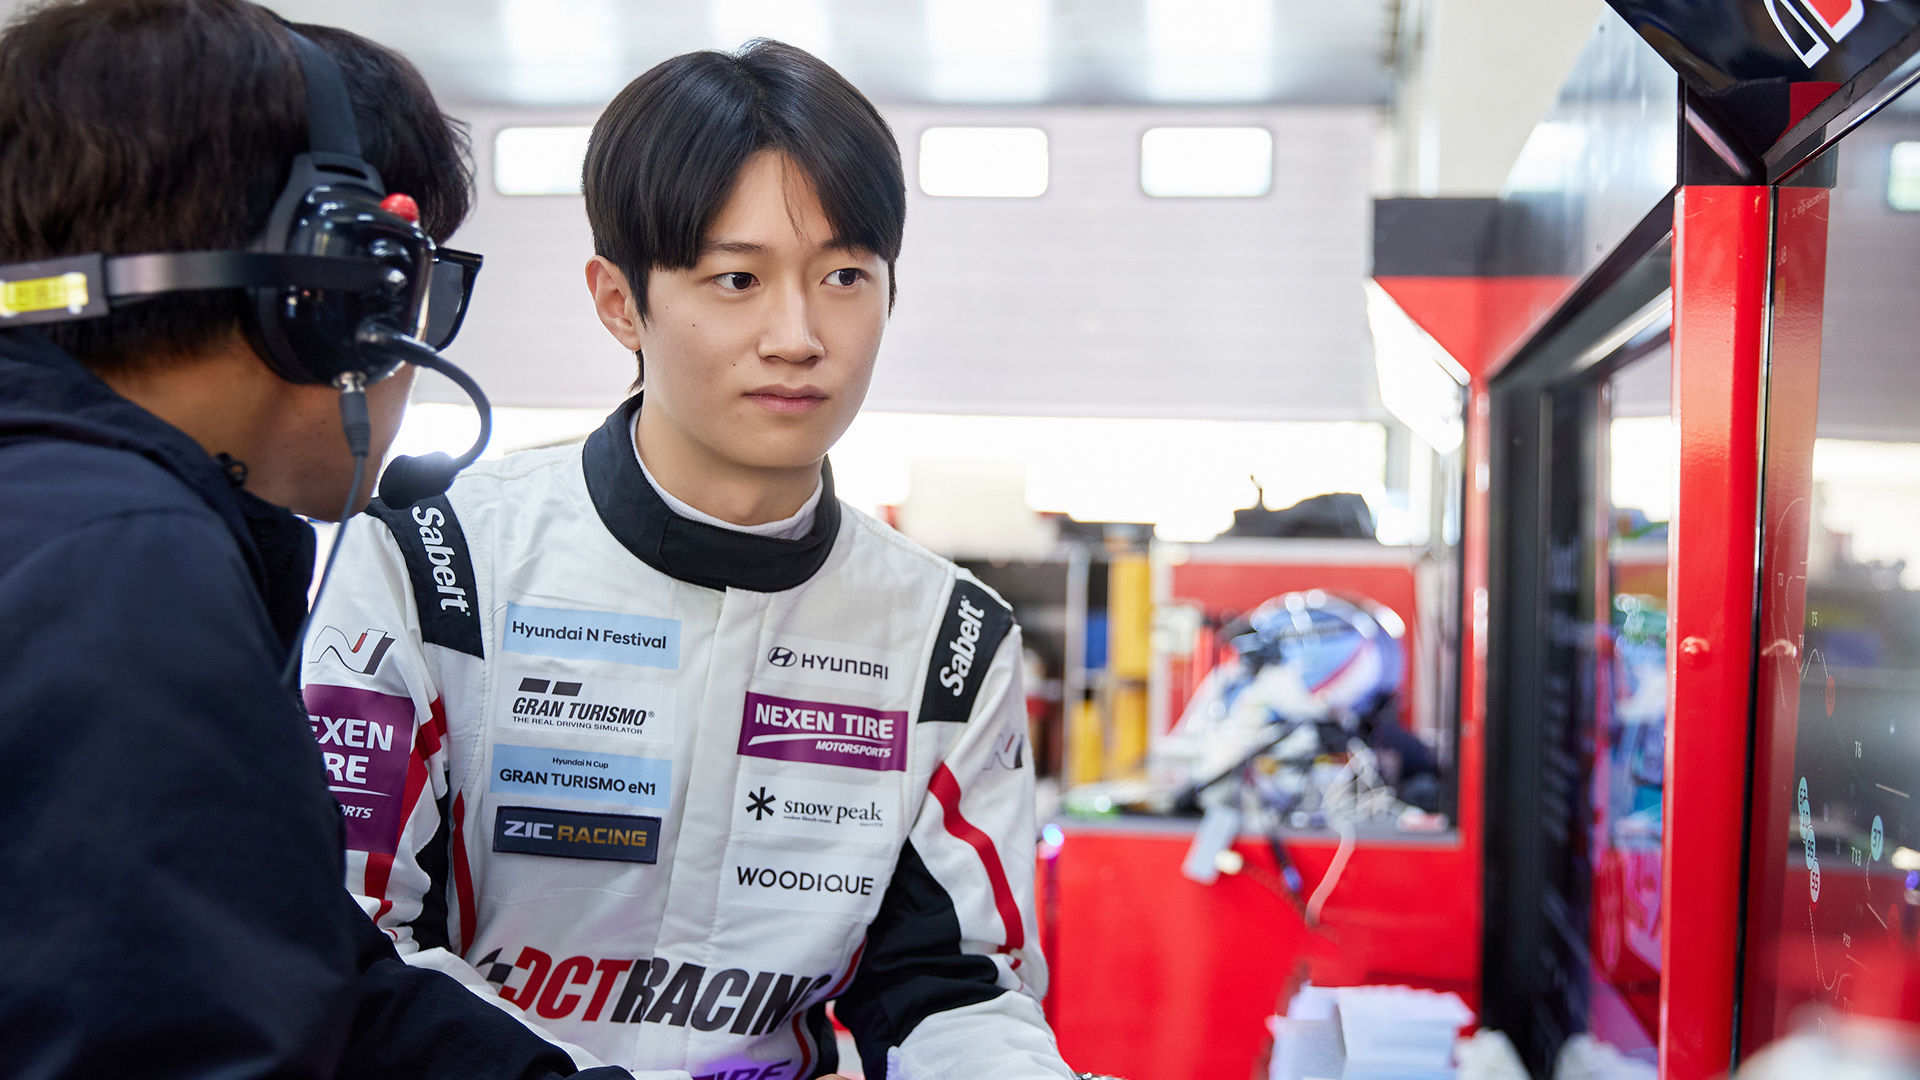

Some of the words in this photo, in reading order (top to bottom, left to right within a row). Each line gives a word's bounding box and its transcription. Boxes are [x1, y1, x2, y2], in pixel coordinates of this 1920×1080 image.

[411, 506, 469, 611] Sabelt
[512, 620, 583, 641] Hyundai
[586, 628, 599, 642] N
[603, 630, 666, 649] Festival
[940, 599, 985, 697] Sabelt
[801, 653, 889, 680] HYUNDAI
[512, 697, 565, 718] GRAN
[755, 702, 835, 732] NEXEN
[841, 713, 894, 739] TIRE
[512, 716, 529, 724] THE
[531, 717, 554, 726] REAL
[556, 720, 592, 730] DRIVING
[593, 723, 643, 735] SIMULATOR
[815, 740, 892, 759] MOTORSPORTS
[1854, 741, 1862, 759] T6
[552, 757, 585, 767] Hyundai
[585, 760, 593, 768] N
[593, 761, 609, 770] Cup
[499, 768, 548, 785] GRAN
[551, 773, 625, 793] TURISMO
[628, 782, 656, 796] eN1
[783, 800, 834, 817] snow
[835, 801, 882, 824] peak
[504, 820, 554, 840] ZIC
[557, 825, 648, 847] RACING
[1851, 846, 1862, 866] T13
[736, 866, 875, 896] WOODIQUE
